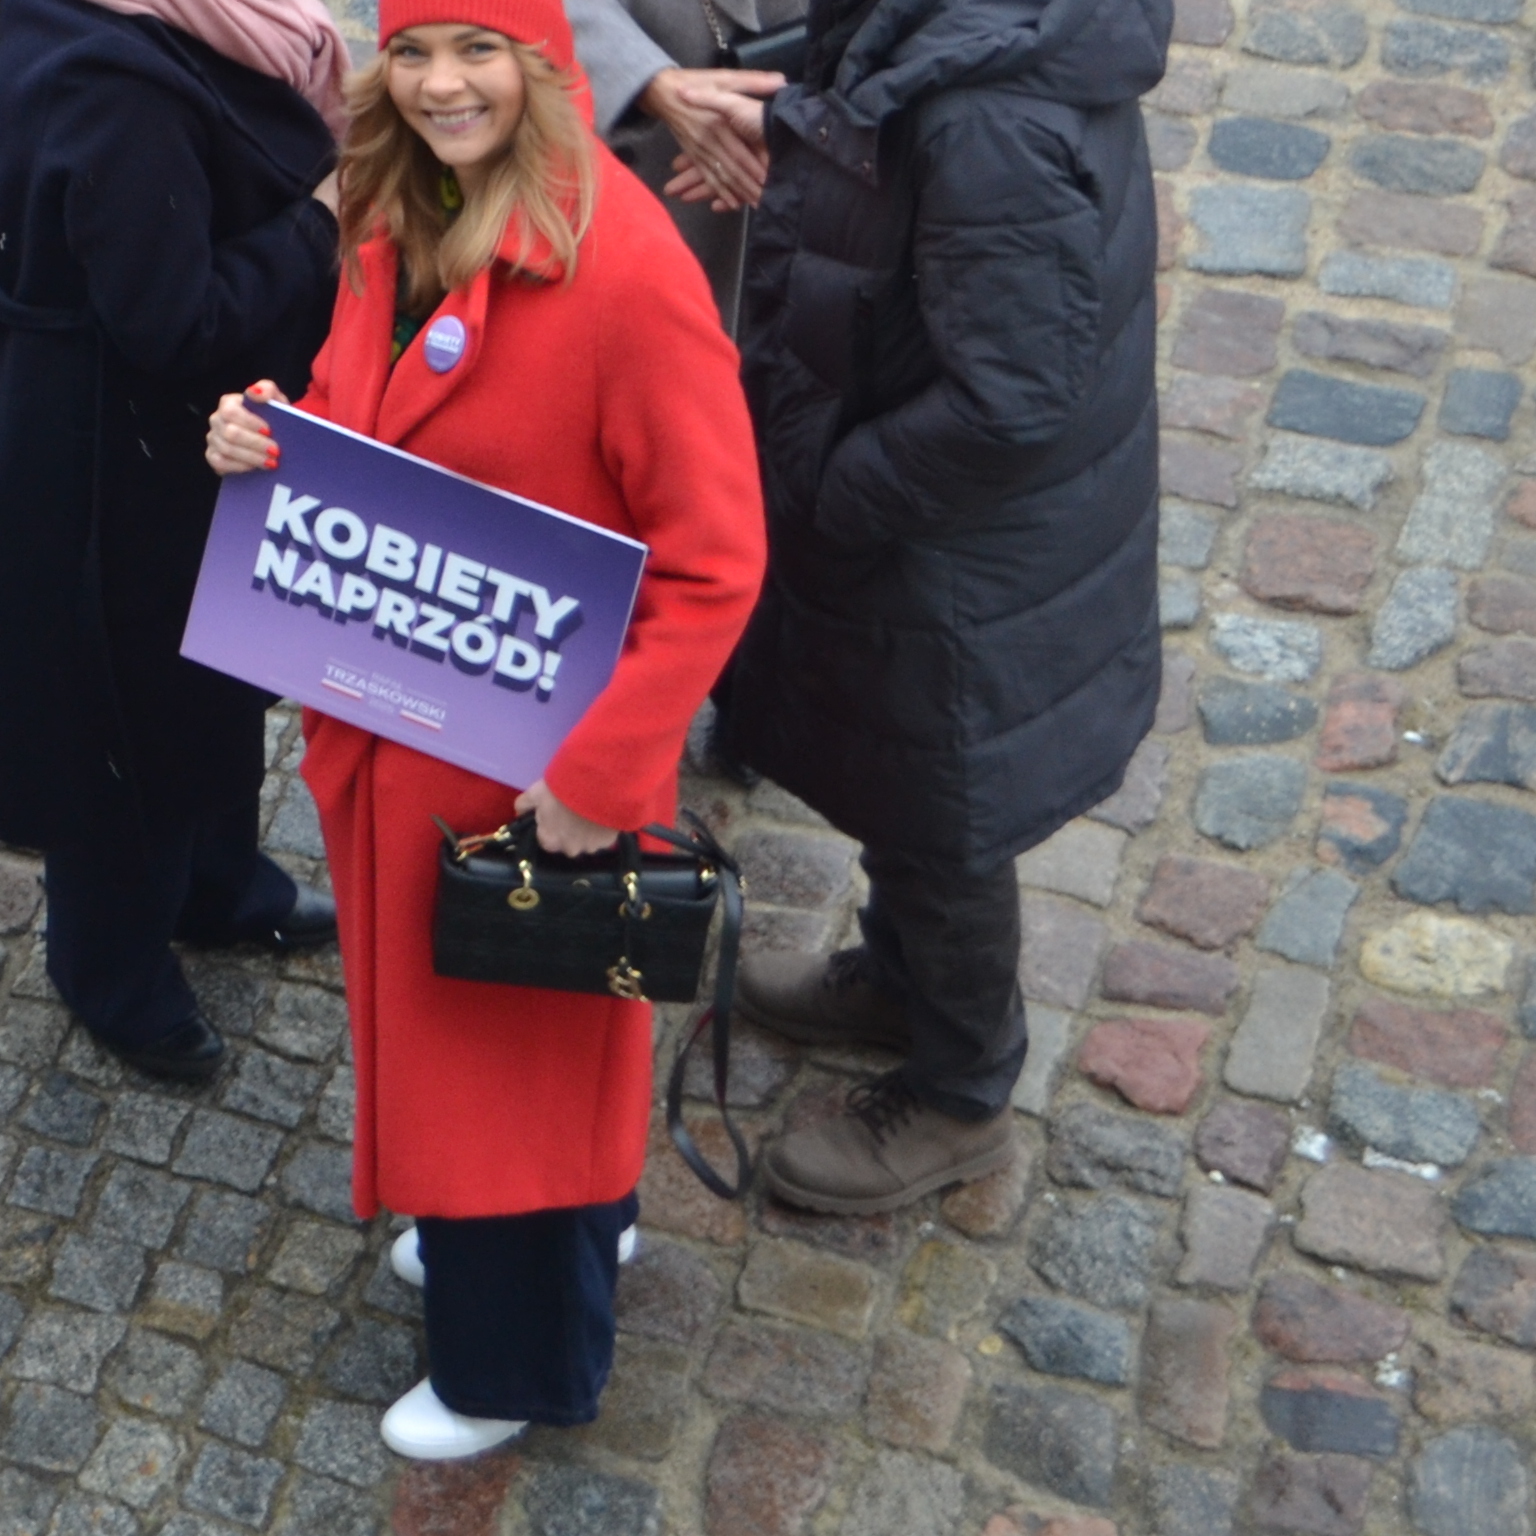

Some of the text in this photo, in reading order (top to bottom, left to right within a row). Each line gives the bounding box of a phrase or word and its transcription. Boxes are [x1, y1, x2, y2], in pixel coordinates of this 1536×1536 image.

[253, 538, 563, 692] NAPRZÓD!
[264, 483, 580, 641] KOBIETY
[325, 664, 446, 720] TRZASKOWSKI
